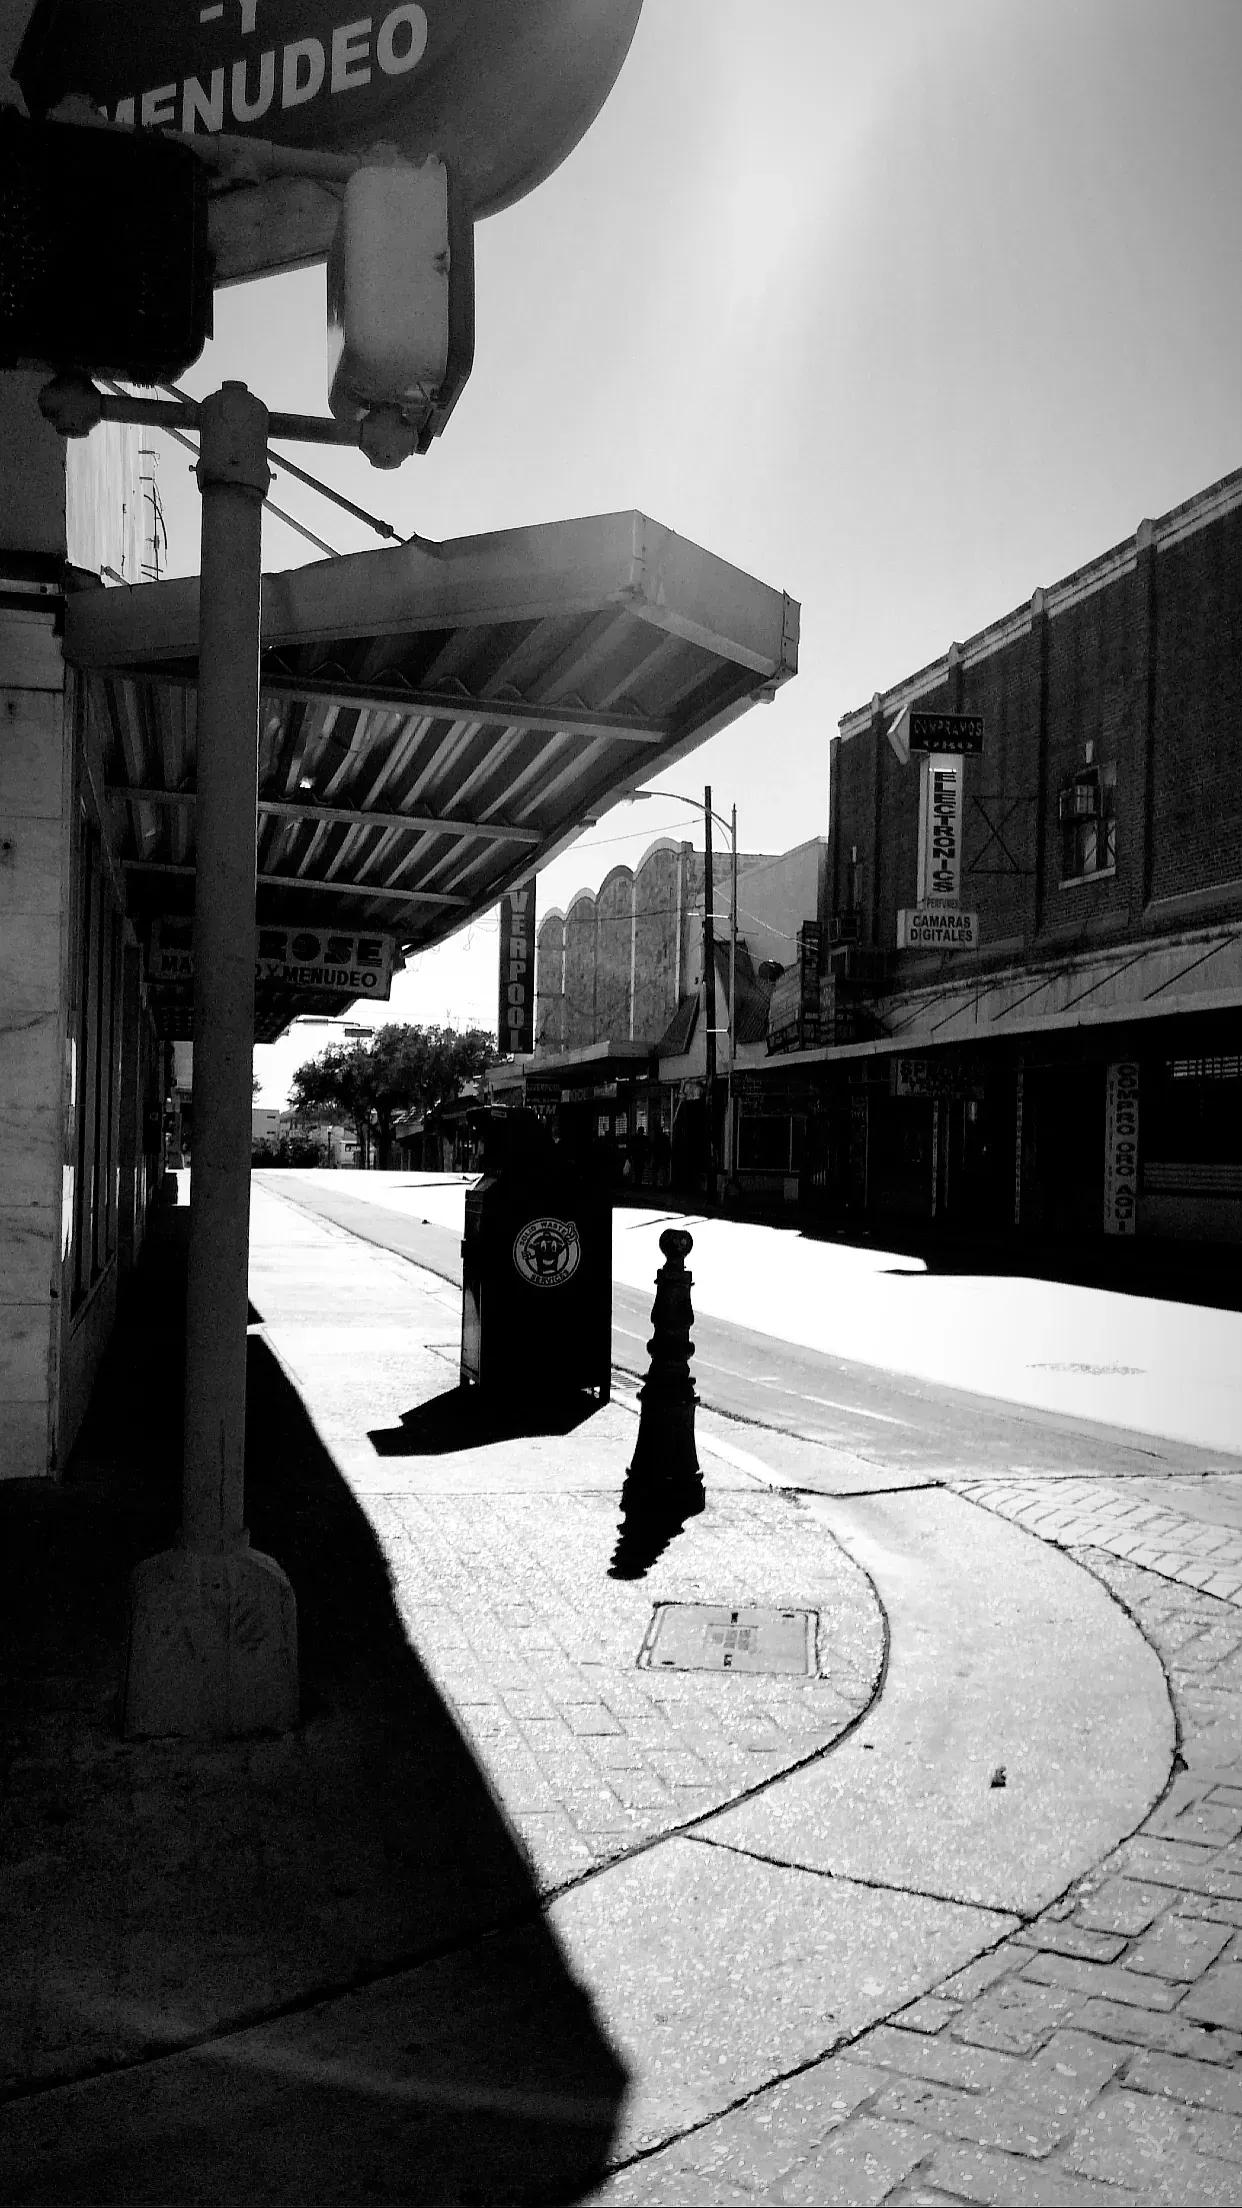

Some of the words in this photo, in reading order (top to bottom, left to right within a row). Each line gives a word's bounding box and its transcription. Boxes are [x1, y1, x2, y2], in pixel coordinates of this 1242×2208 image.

[933, 771, 957, 893] ELECTRONICS
[912, 916, 971, 929] CAMARAS
[910, 928, 973, 942] DIGITALES
[282, 965, 378, 989] MENUDEO
[1115, 1142, 1136, 1177] ORO
